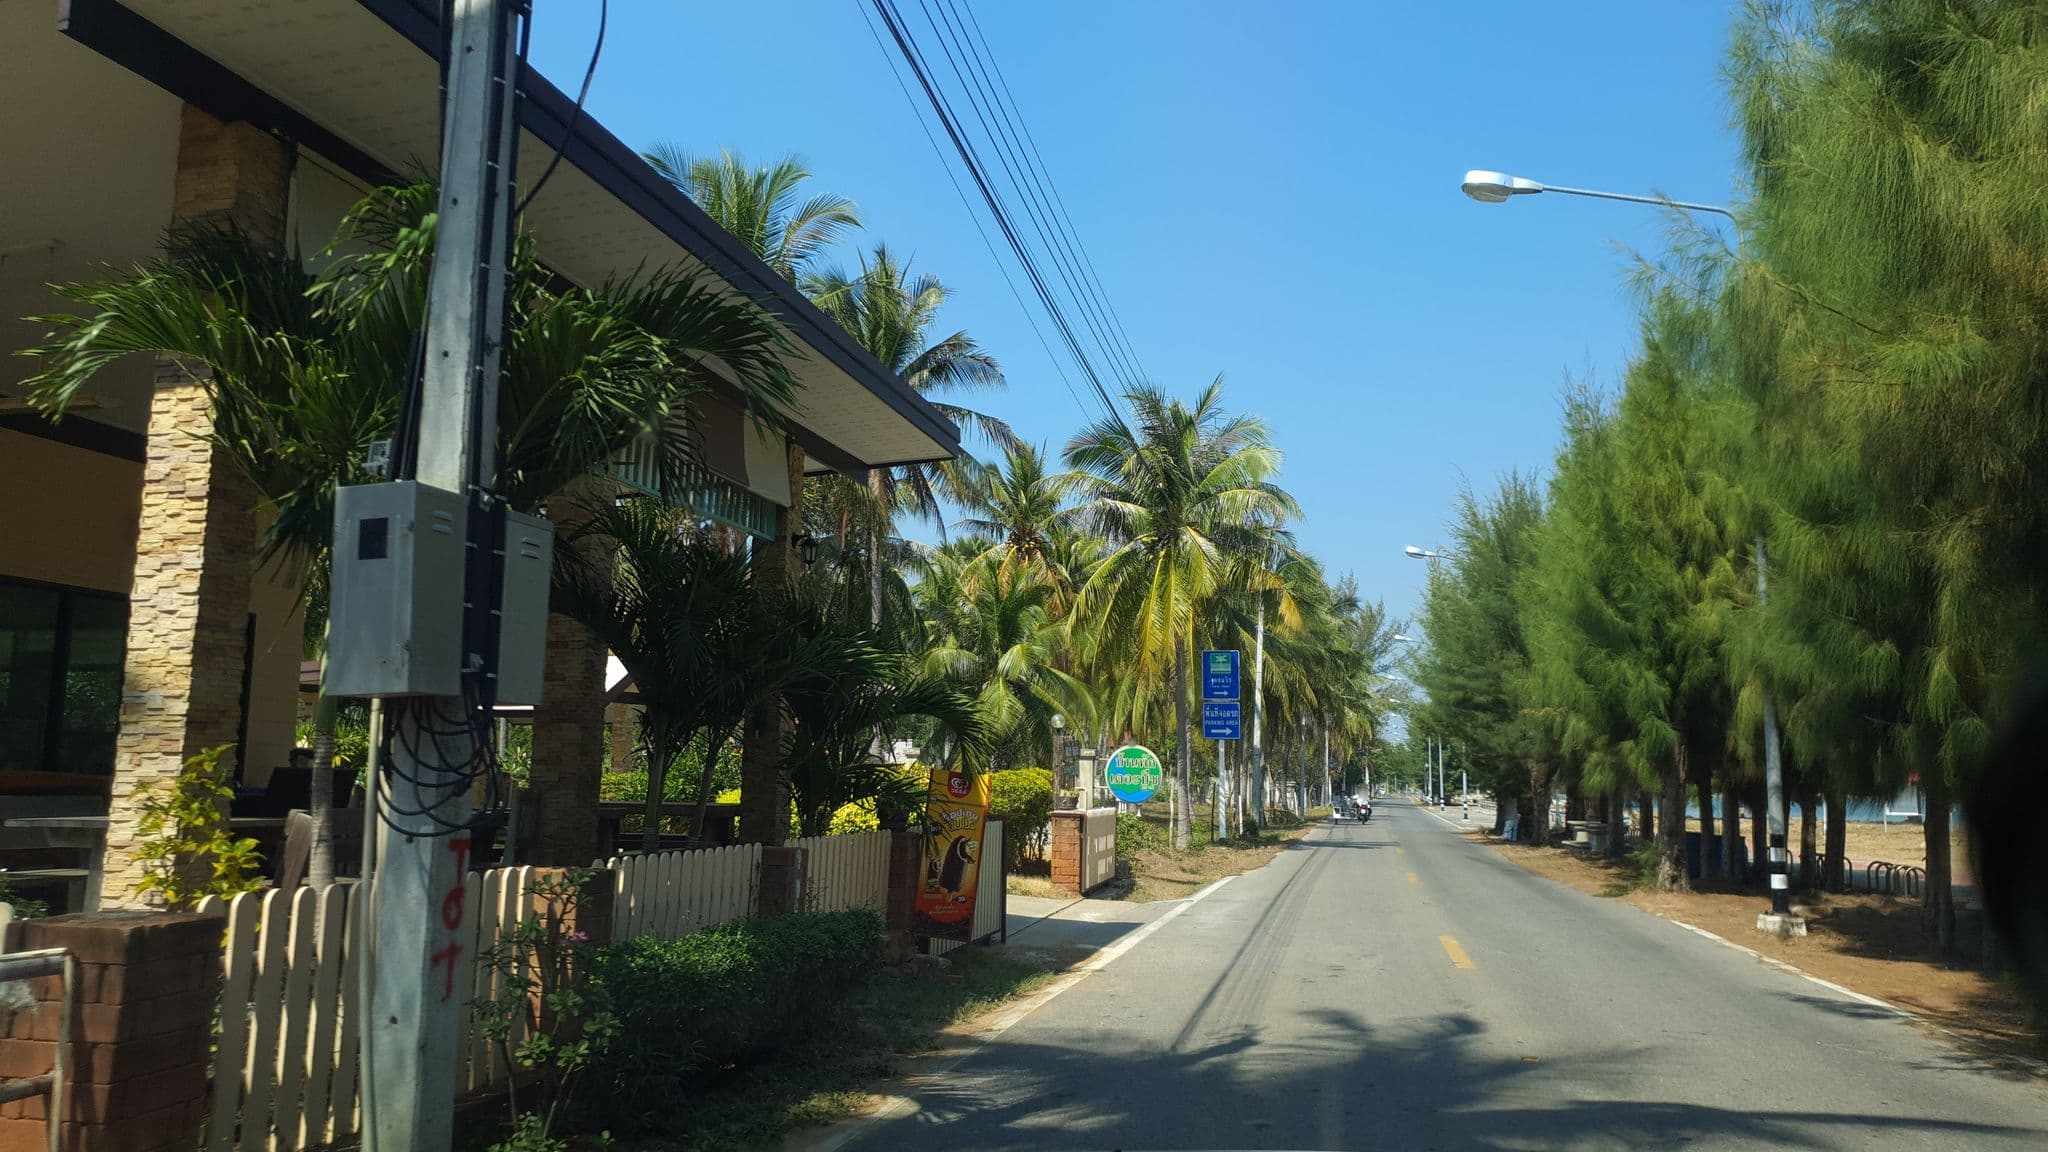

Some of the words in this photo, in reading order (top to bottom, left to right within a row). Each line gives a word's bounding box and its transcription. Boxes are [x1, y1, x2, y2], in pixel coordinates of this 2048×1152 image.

[1205, 704, 1239, 718] พื้นที่จอดรถ
[1115, 752, 1157, 768] บ้านพัก
